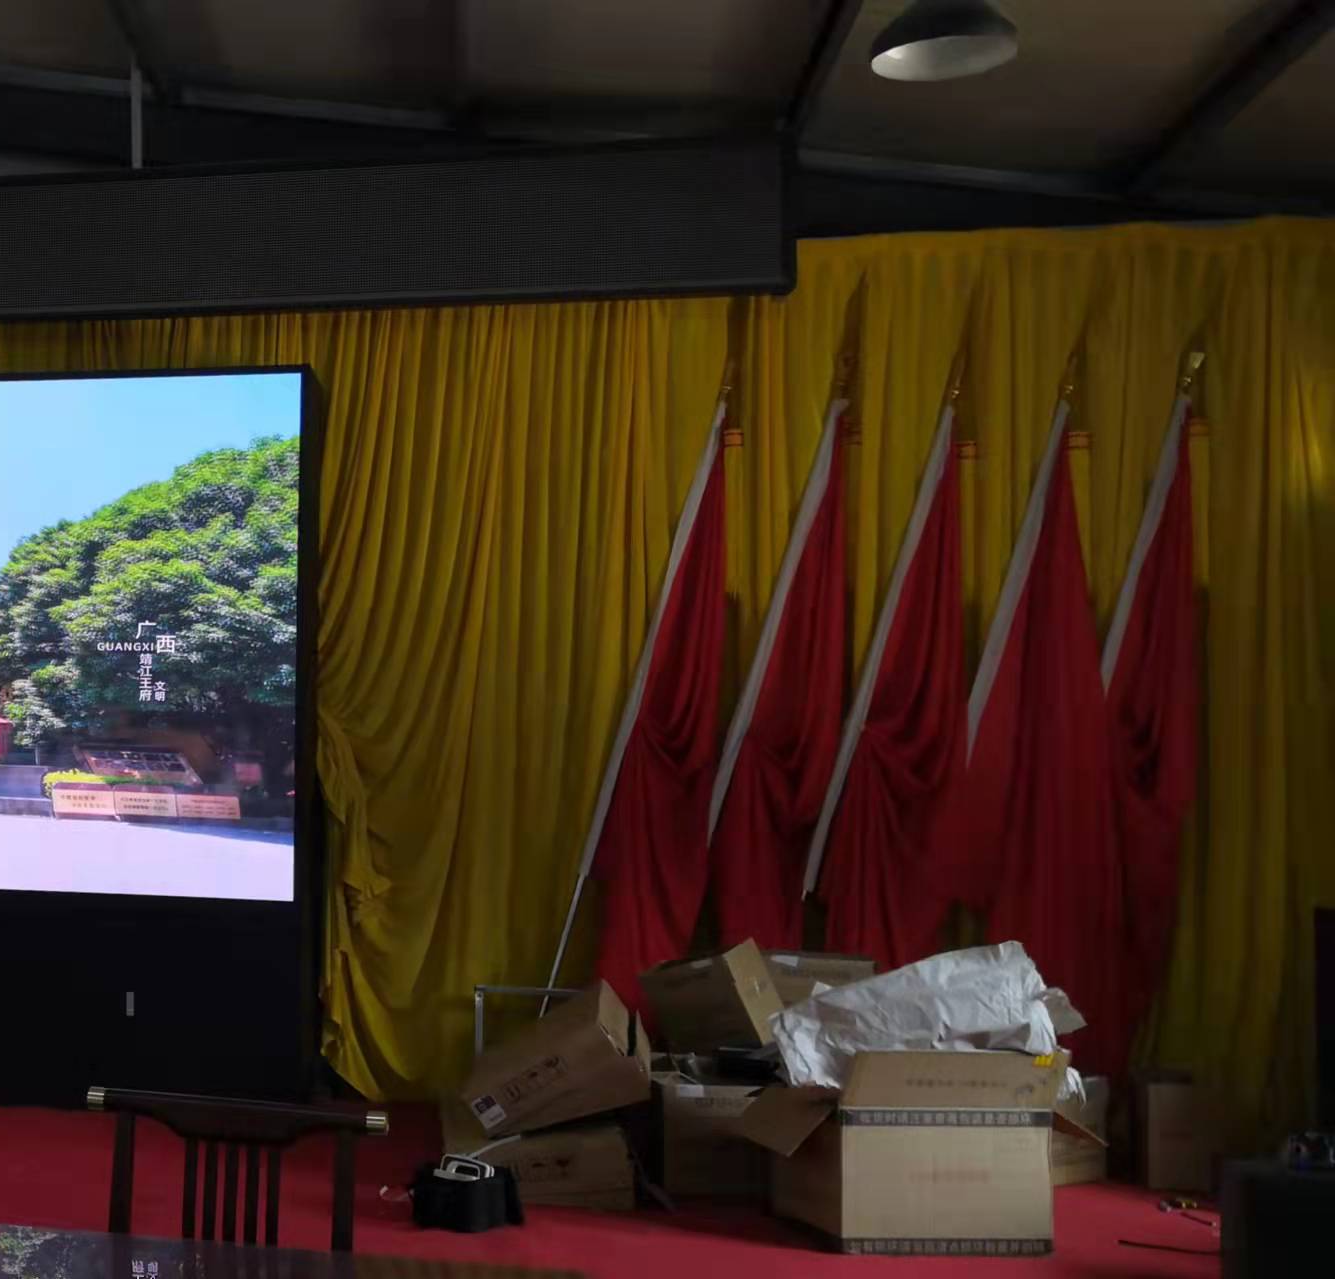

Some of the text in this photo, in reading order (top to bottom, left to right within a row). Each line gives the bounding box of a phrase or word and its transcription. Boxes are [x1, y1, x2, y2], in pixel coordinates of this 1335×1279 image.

[96, 641, 154, 652] GUANGXI
[138, 653, 153, 702] 靖江王府
[153, 680, 166, 702] 文明
